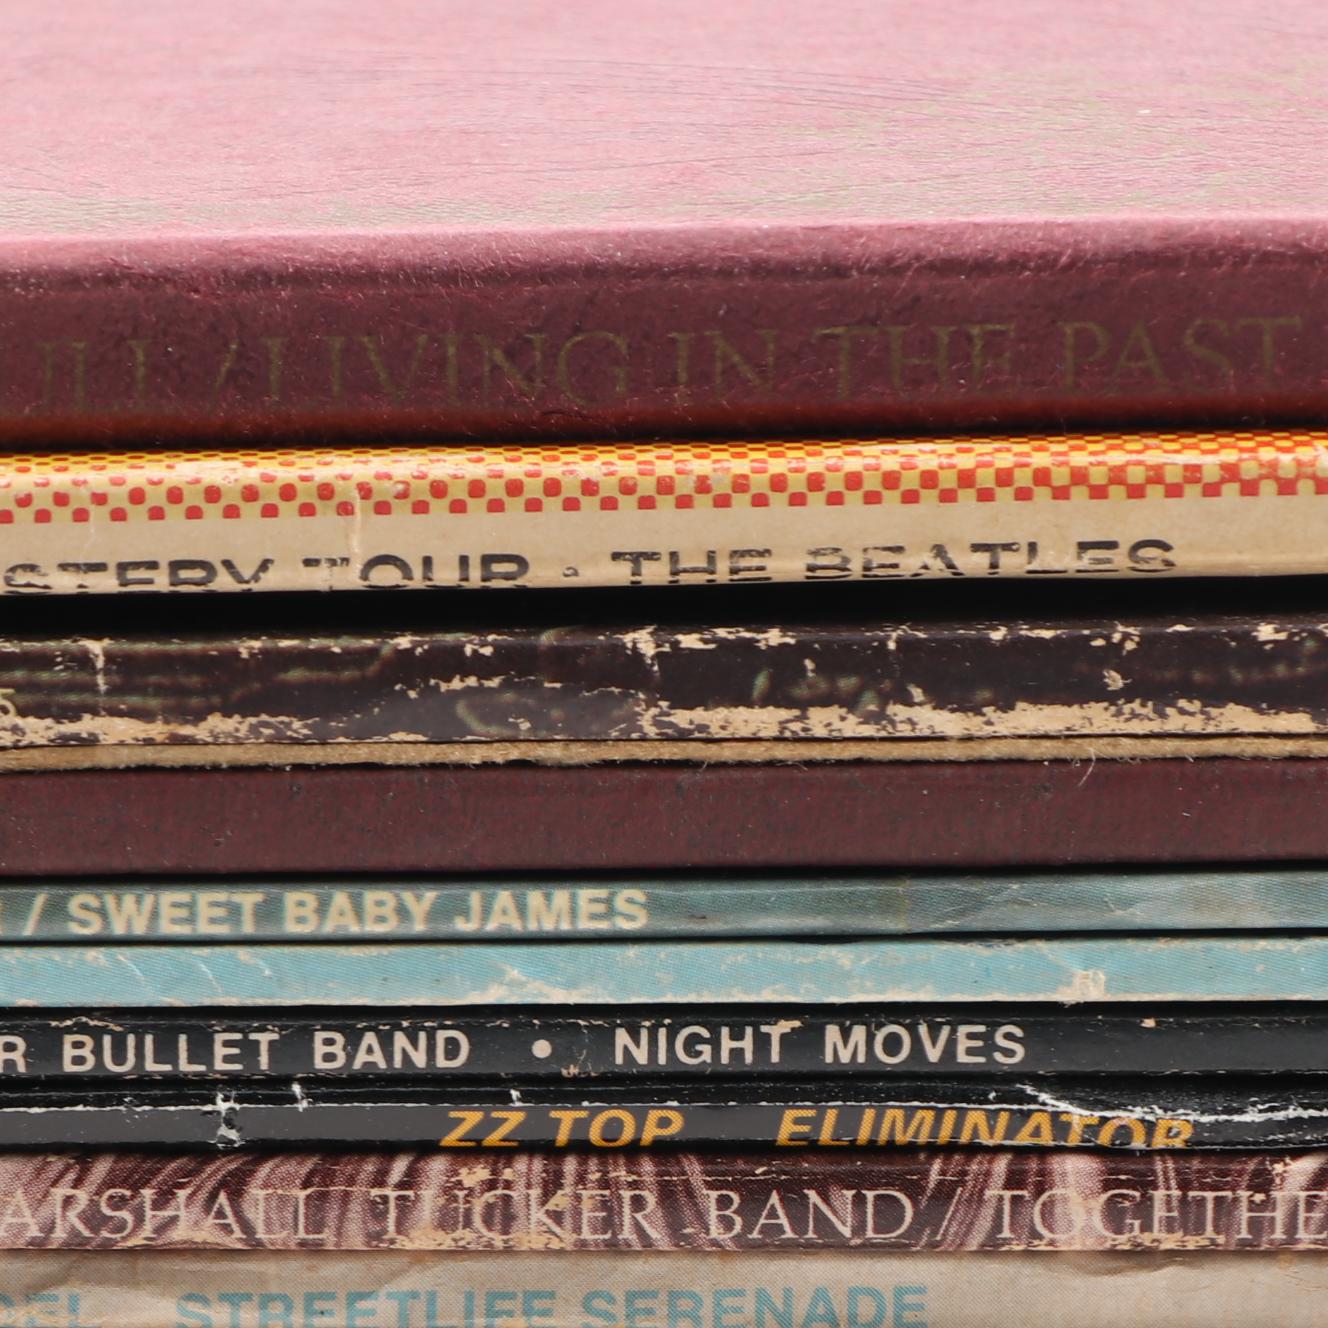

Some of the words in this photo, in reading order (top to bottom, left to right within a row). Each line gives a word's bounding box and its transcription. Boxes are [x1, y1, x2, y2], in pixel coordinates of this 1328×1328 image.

[669, 328, 777, 402] IN
[811, 321, 1018, 400] THE
[1058, 316, 1304, 395] PAST
[611, 548, 773, 586] THE
[805, 538, 1177, 582] BEATLES
[22, 891, 49, 937] /
[66, 890, 265, 936] SWEET
[282, 889, 440, 934] BABY
[453, 887, 650, 931] JAMES
[62, 1031, 280, 1073] BULLET
[312, 1028, 471, 1070] BAND
[613, 1024, 792, 1067] NIGHT
[823, 1024, 1026, 1066] MOVES
[438, 1110, 528, 1148] ZZ
[550, 1108, 685, 1148] TOP
[773, 1106, 1196, 1150] ELIMINATOR
[371, 1188, 661, 1240] TUCKER
[707, 1188, 915, 1240] BAND
